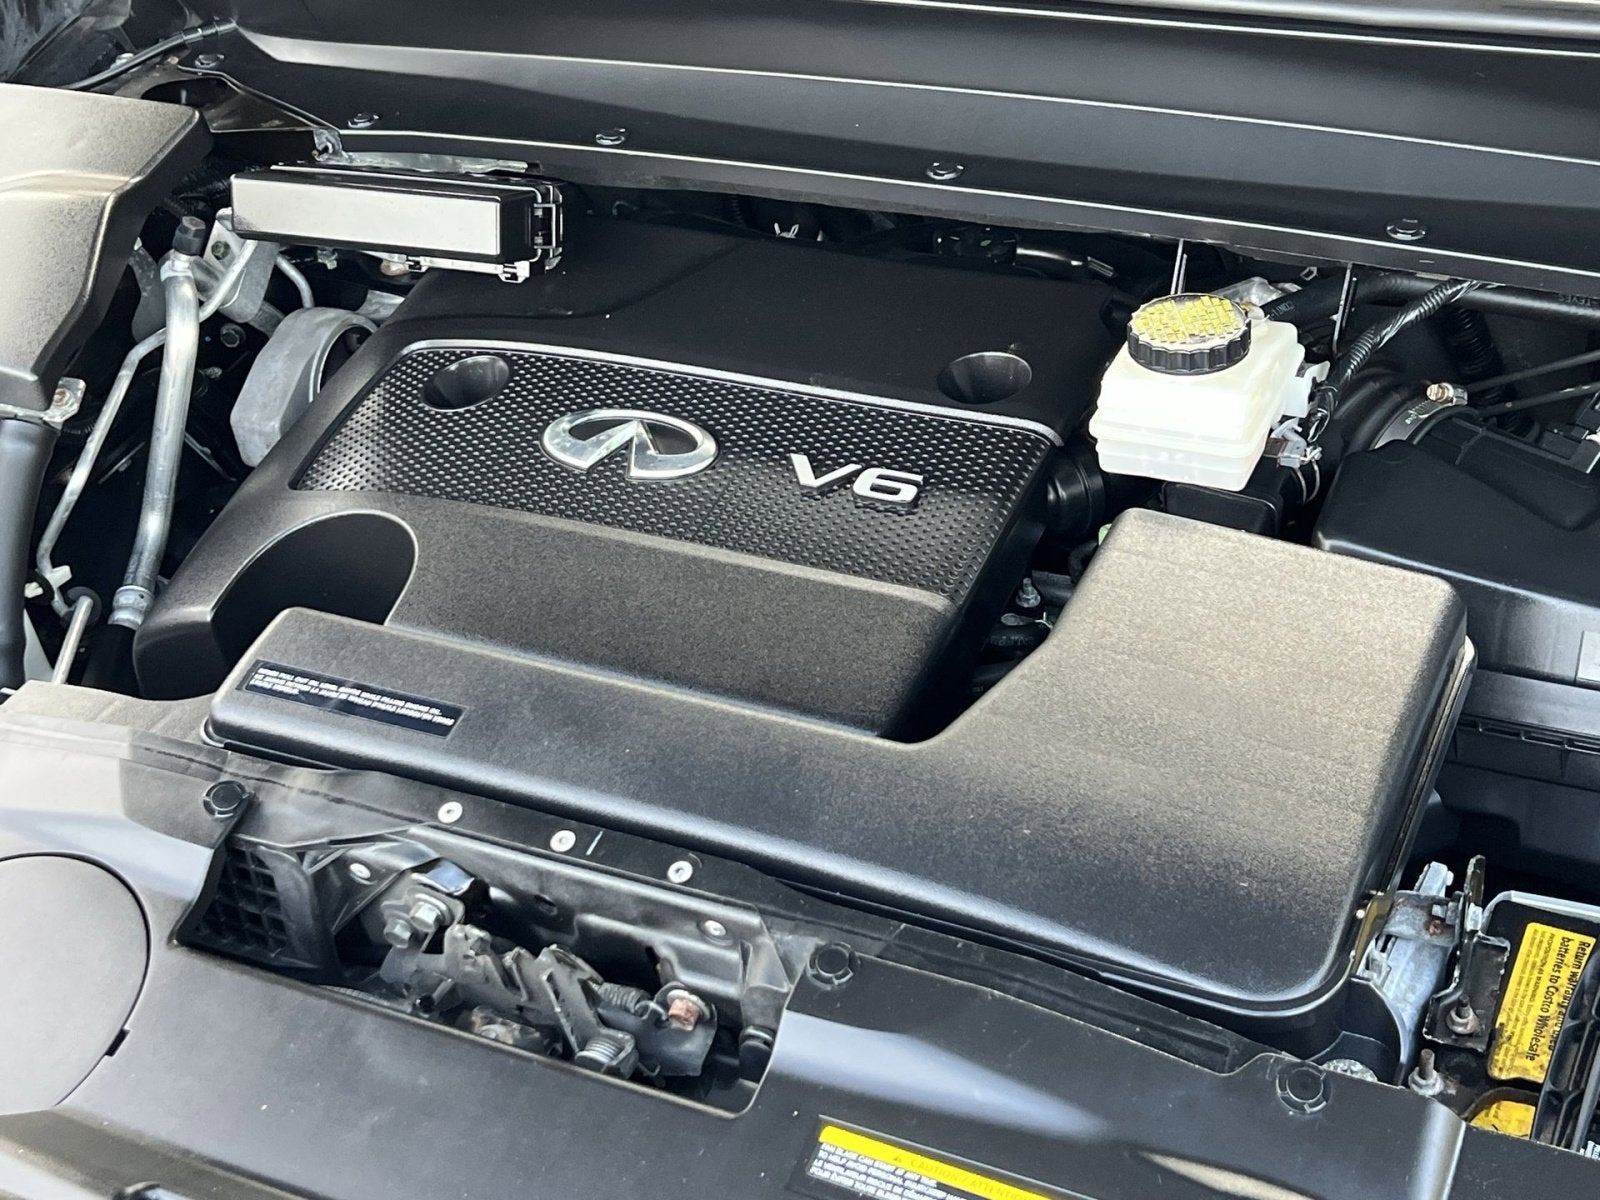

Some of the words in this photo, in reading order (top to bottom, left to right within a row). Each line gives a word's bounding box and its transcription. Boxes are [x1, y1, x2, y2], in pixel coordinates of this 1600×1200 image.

[790, 453, 924, 503] V6
[1552, 936, 1573, 974] batteries
[1572, 941, 1590, 970] Return
[1548, 974, 1559, 984] to
[1540, 985, 1559, 1014] Costco
[1525, 1016, 1549, 1062] Wholesale
[911, 1159, 957, 1181] CAUTION
